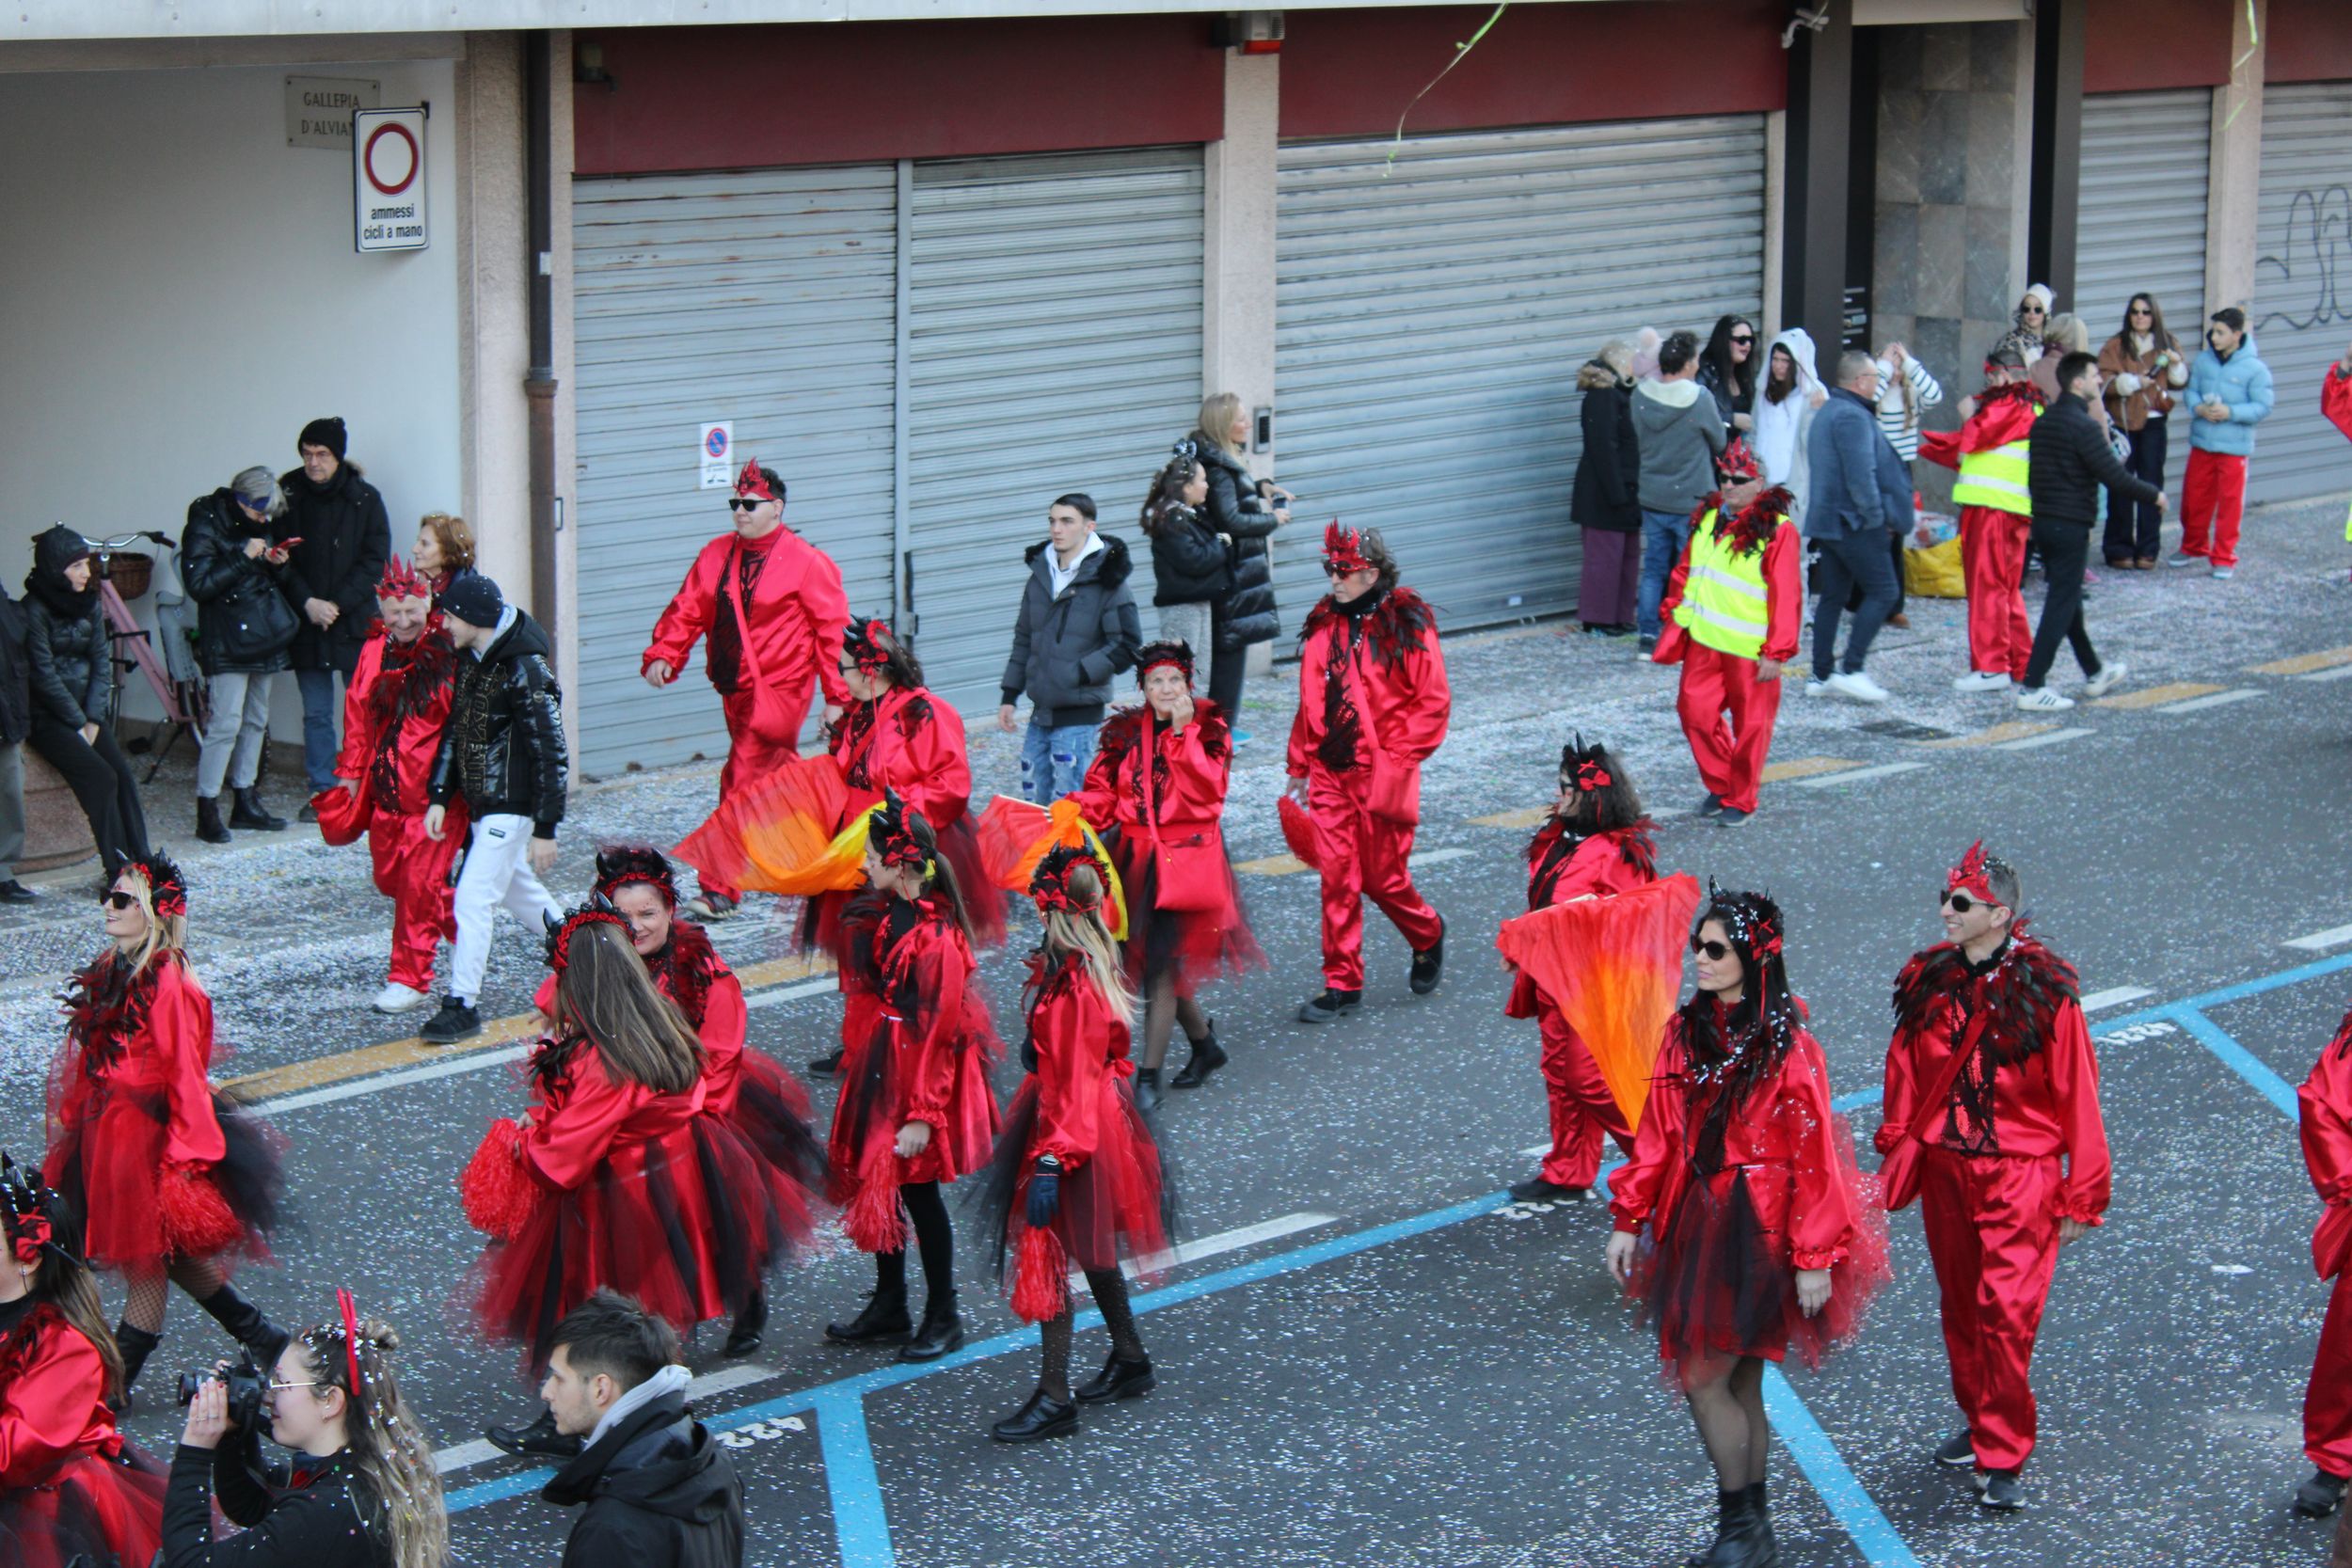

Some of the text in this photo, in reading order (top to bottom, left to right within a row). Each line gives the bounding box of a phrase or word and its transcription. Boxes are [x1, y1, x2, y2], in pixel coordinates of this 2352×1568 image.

[303, 91, 360, 110] GALLERIA
[371, 202, 415, 220] ammessi
[363, 225, 422, 240] cicli a mano
